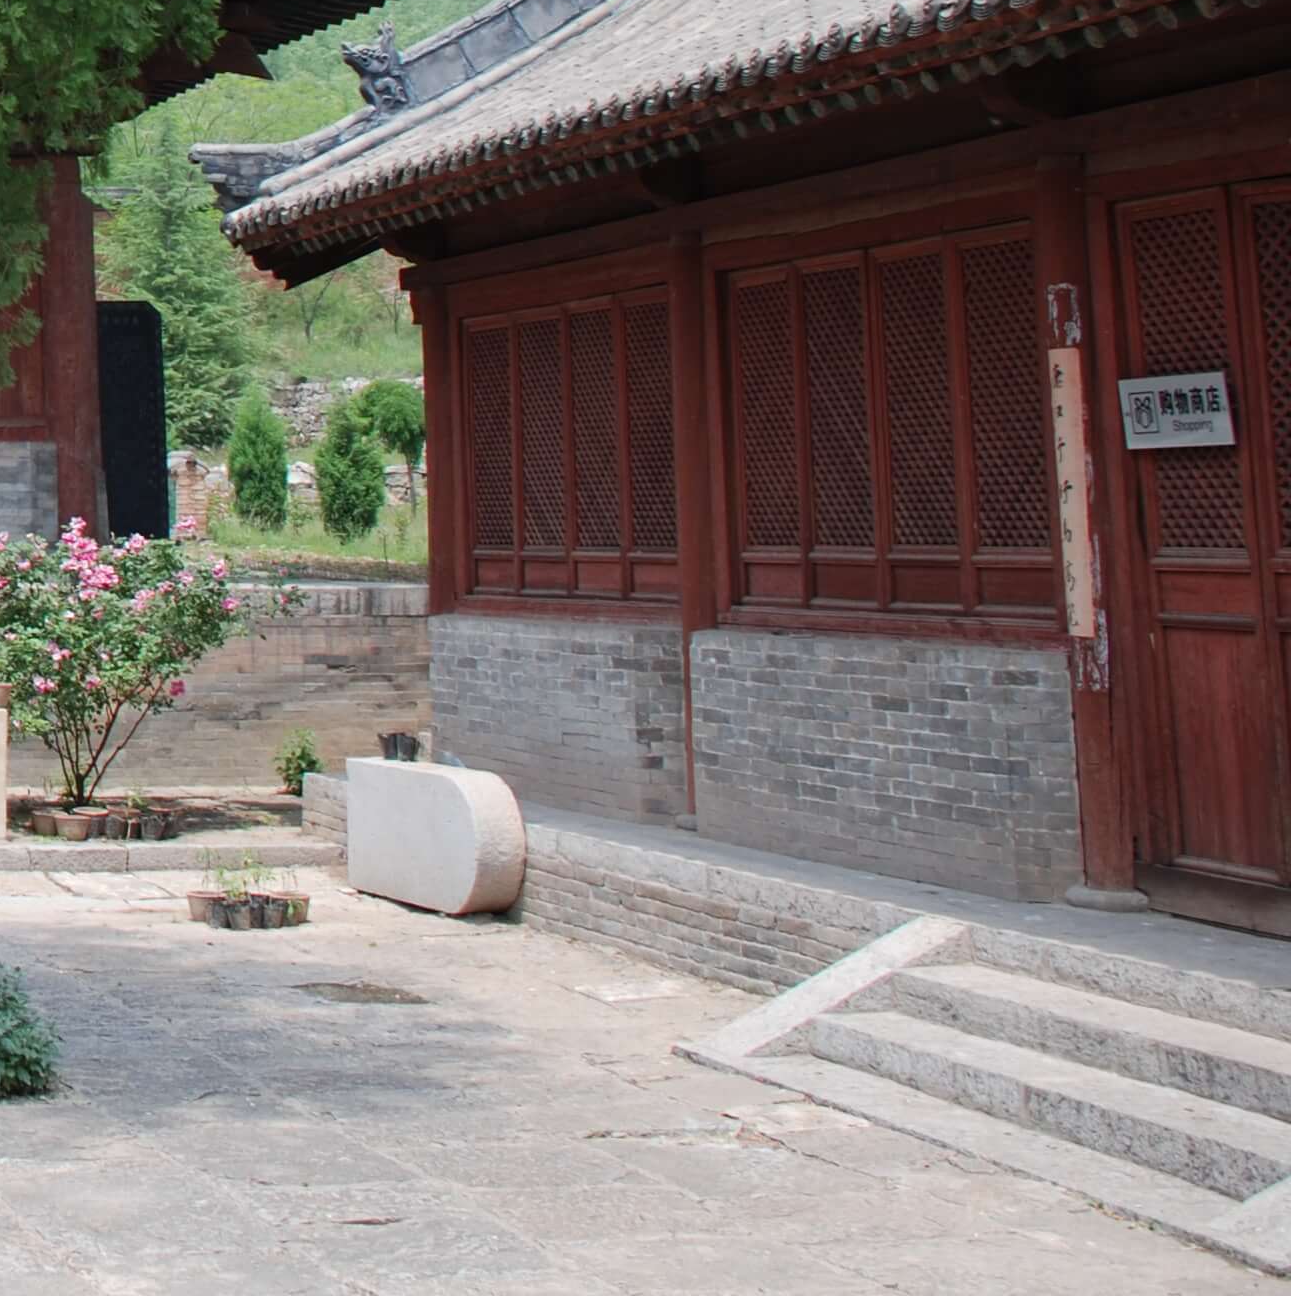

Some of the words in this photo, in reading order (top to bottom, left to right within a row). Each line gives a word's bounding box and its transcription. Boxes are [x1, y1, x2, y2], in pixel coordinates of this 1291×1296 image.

[1158, 385, 1221, 416] 购物商店
[1172, 419, 1214, 432] Shopping
